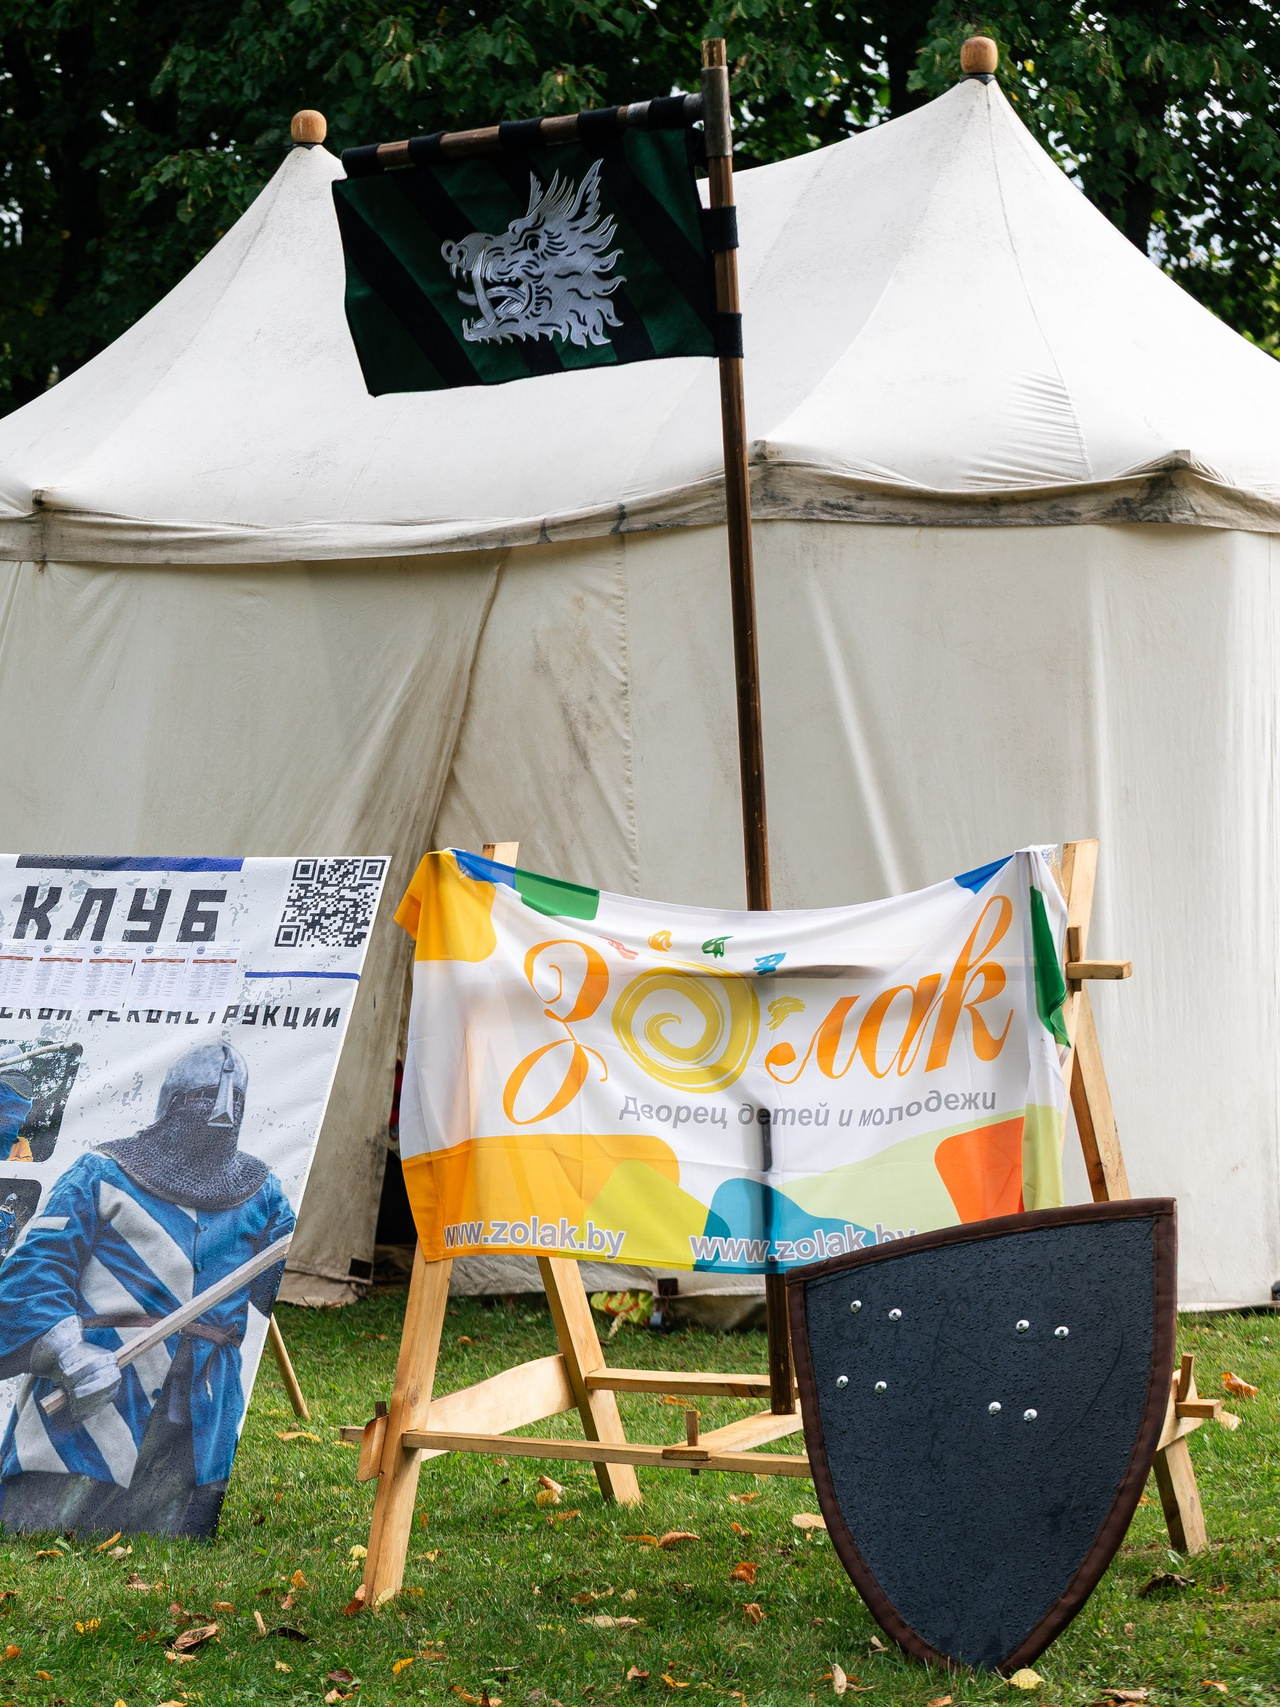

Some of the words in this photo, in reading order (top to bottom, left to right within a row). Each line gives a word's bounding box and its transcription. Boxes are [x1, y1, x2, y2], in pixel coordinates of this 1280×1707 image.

[13, 886, 228, 942] КЛУБ
[619, 1095, 728, 1130] Дворец
[737, 1102, 830, 1128] детей
[838, 1108, 853, 1127] и
[858, 1089, 997, 1128] молодежи
[443, 1215, 626, 1259] www.zolak.by
[688, 1222, 917, 1264] www.zolakb
